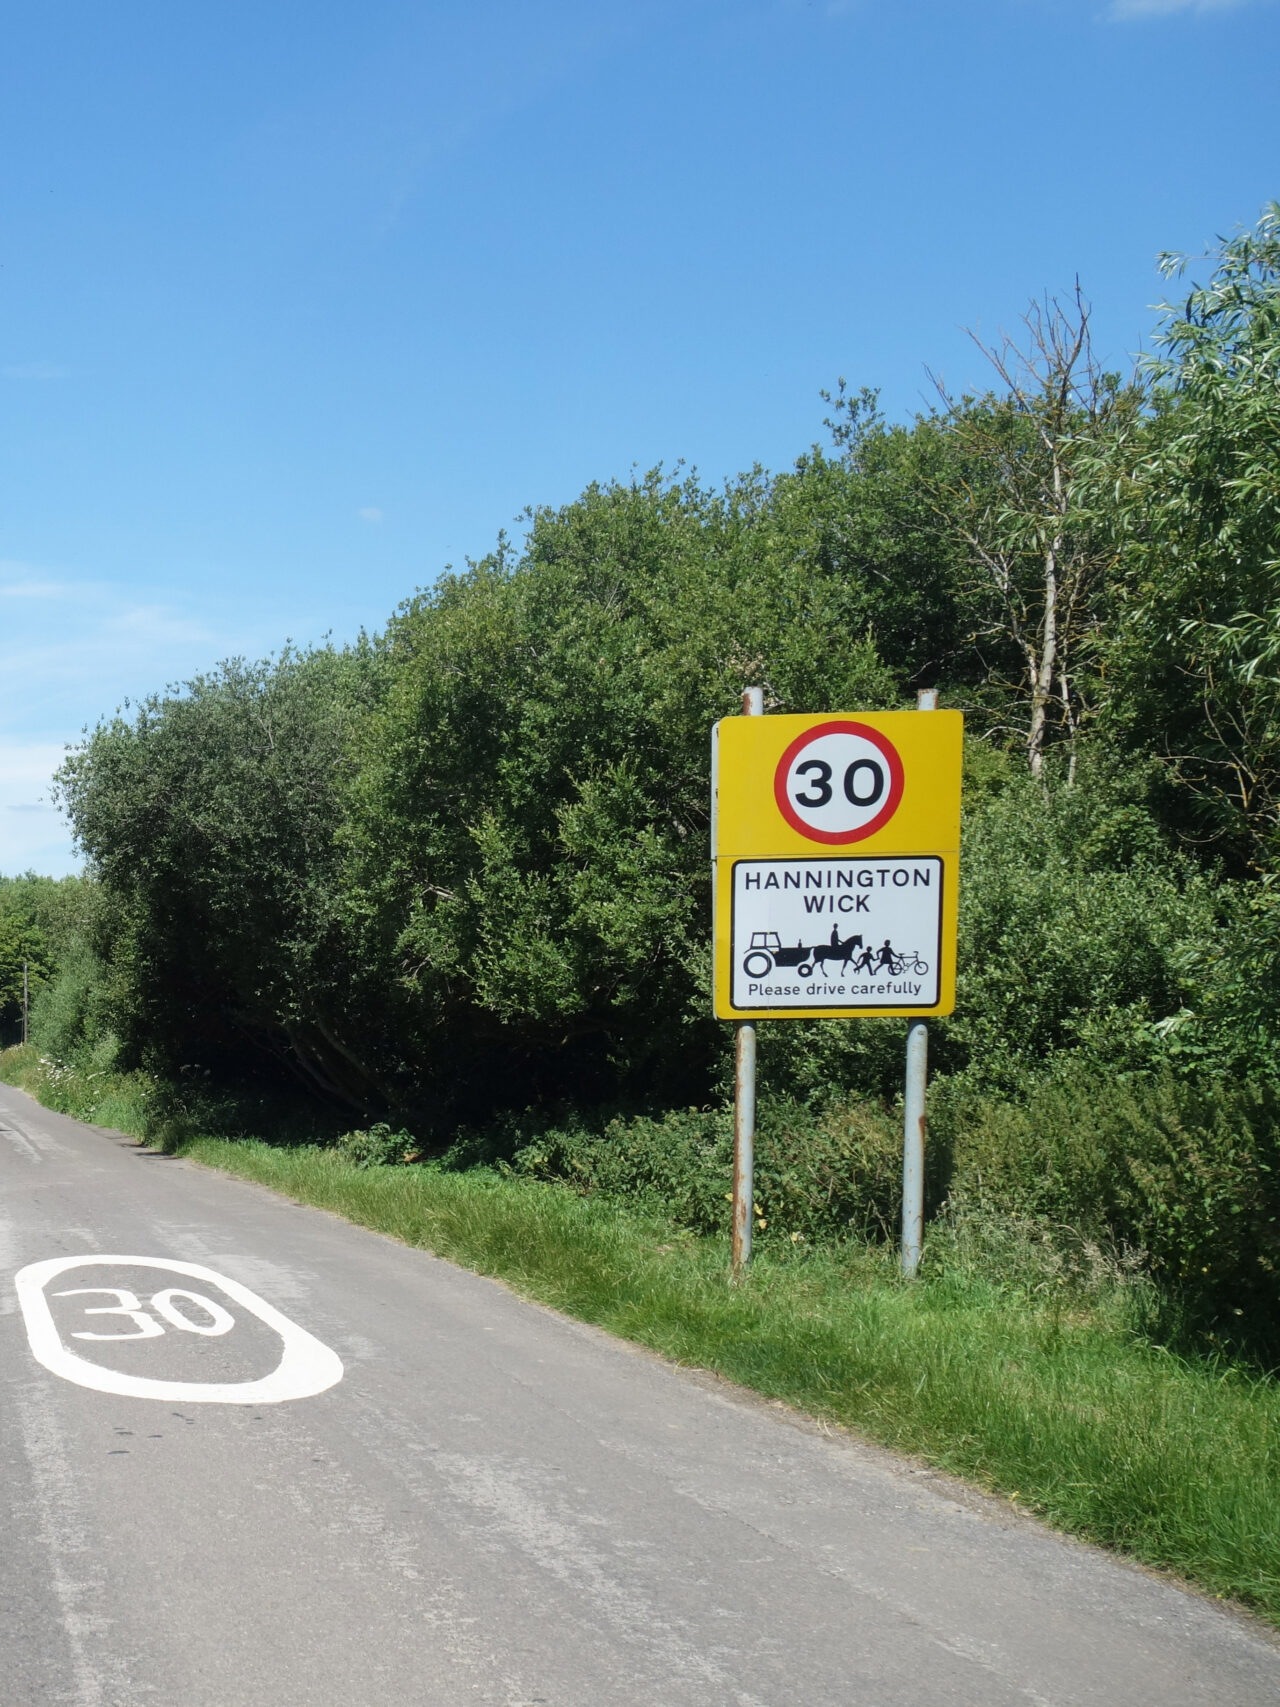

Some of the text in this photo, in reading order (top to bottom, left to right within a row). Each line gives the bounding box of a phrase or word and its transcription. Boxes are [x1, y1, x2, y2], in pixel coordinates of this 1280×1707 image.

[795, 758, 884, 808] 30
[745, 868, 931, 890] HANNINGTON
[804, 894, 871, 913] WICK
[749, 981, 922, 996] Please drive carefully
[52, 1288, 235, 1340] 30
